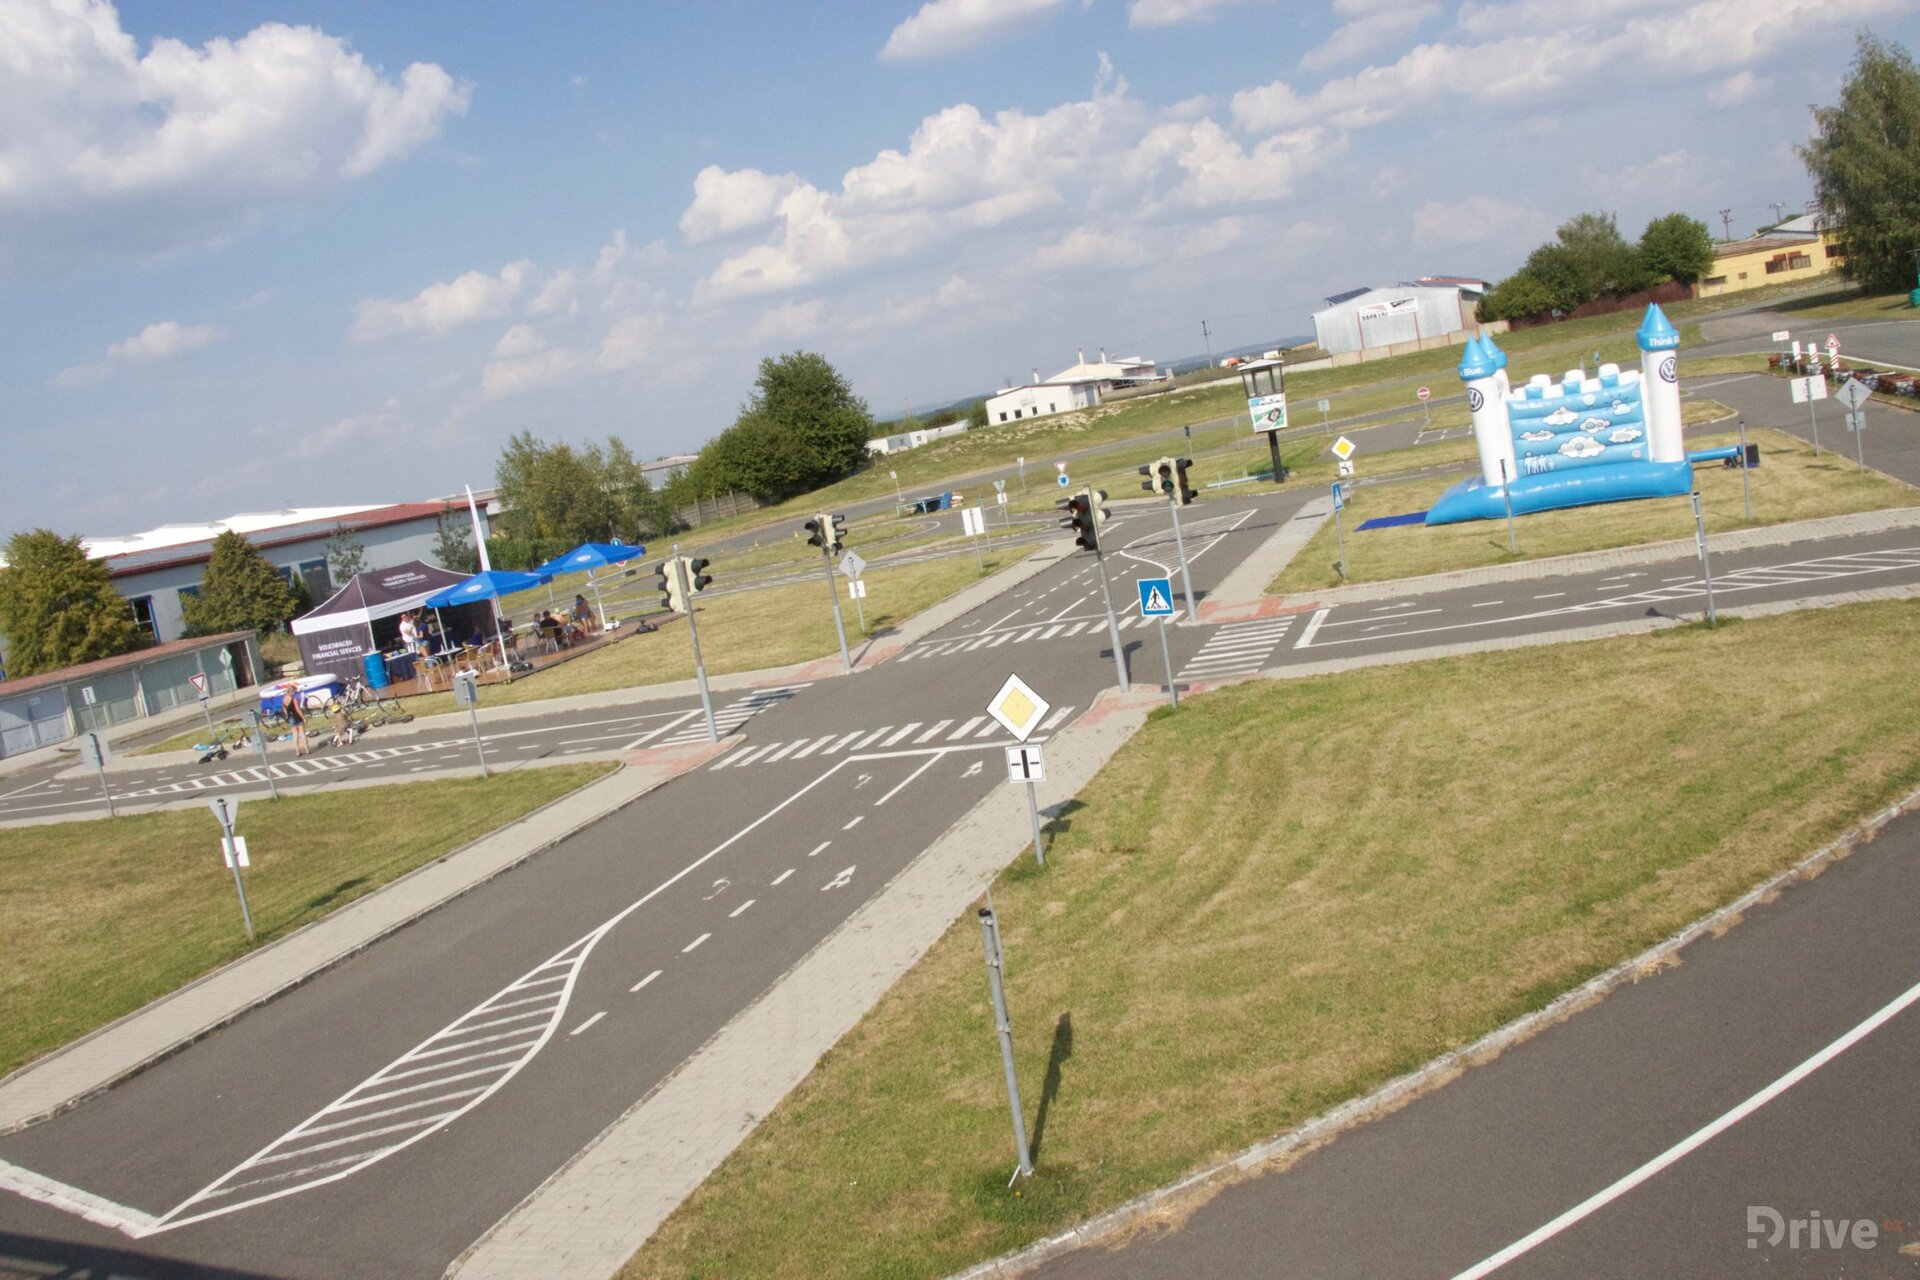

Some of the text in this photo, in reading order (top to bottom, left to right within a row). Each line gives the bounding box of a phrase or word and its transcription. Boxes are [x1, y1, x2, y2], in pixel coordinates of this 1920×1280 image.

[1649, 335, 1674, 346] Think
[318, 640, 353, 651] VOLKSWAGEN
[312, 645, 362, 660] FINANCIAL SERVICES
